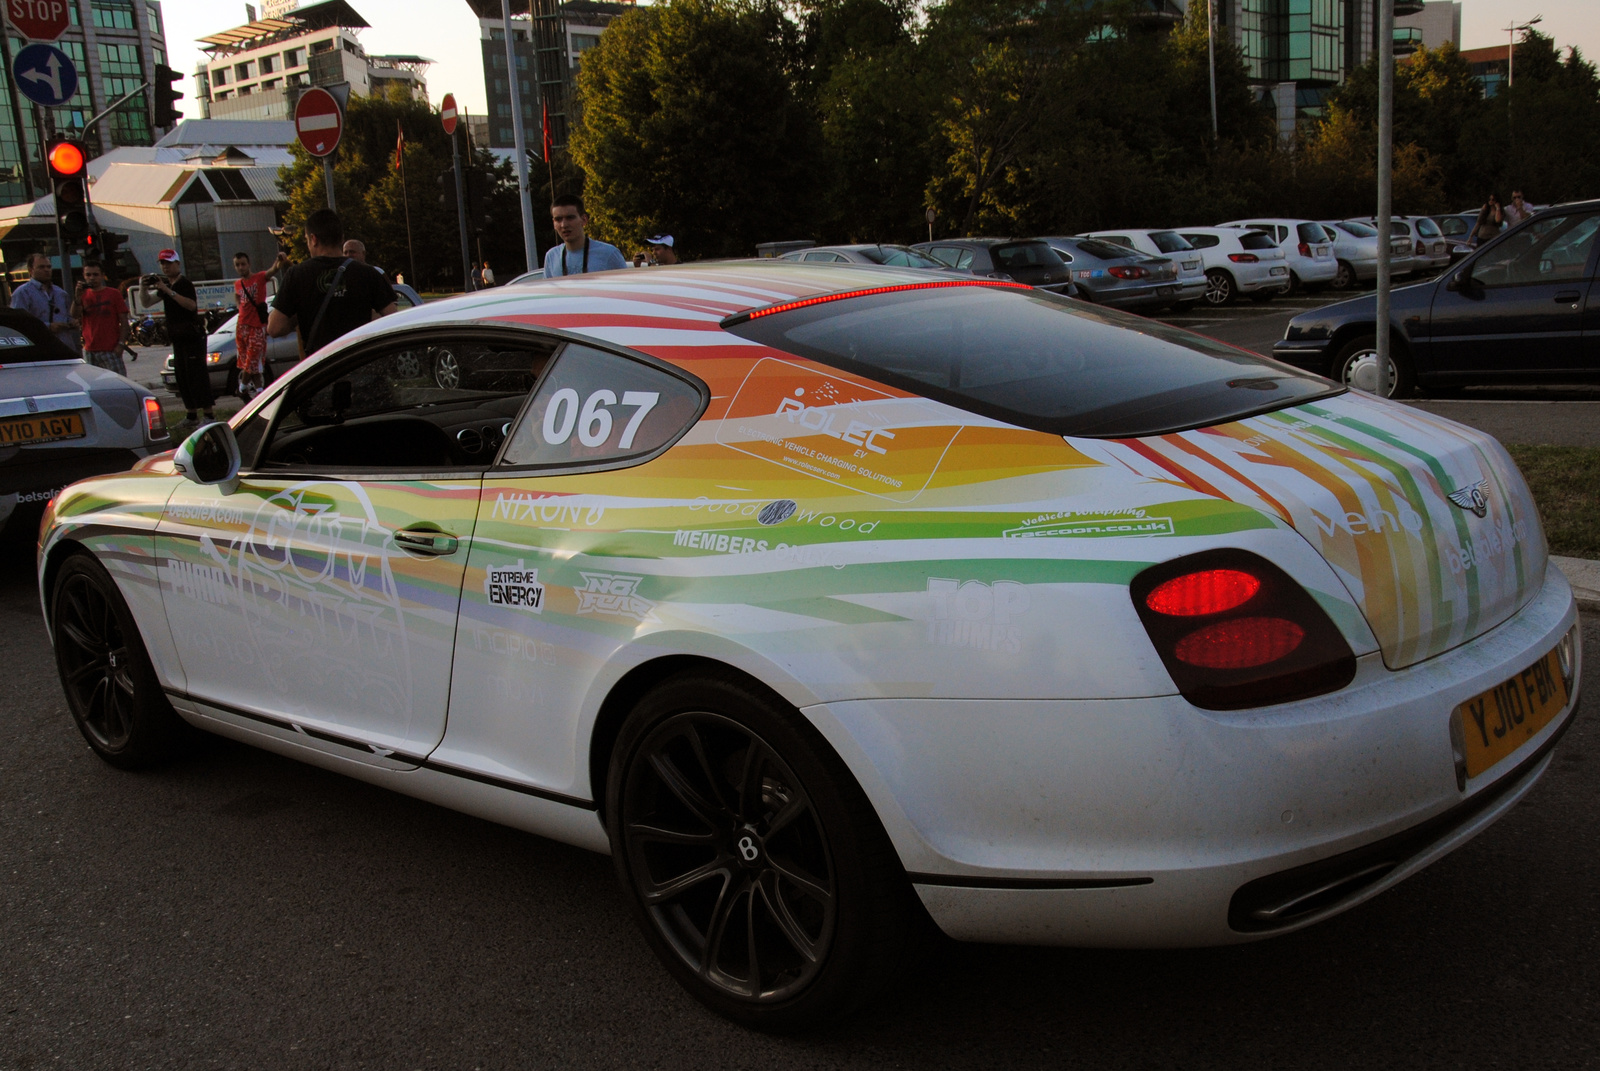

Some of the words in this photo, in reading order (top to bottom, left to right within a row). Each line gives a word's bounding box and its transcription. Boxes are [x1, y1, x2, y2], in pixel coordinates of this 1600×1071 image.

[12, 0, 62, 22] STOP
[197, 285, 235, 295] ONTINENT
[40, 418, 72, 438] AGV
[542, 387, 660, 449] 067
[774, 397, 896, 455] ROLEC
[738, 425, 784, 447] ELECTRONIC
[784, 437, 817, 458] VEHICLE
[816, 452, 857, 472] CHARGING
[857, 466, 903, 488] SOLUTIONS
[853, 448, 868, 459] EV
[782, 455, 841, 480] www.rolecserv.com
[16, 486, 66, 503] betsafe
[491, 492, 583, 523] NIXON
[1021, 511, 1071, 526] Vehicle
[1311, 499, 1423, 538] veho
[673, 529, 769, 555] MEMBERS
[1010, 522, 1167, 539] raccoon.co.uk
[491, 571, 534, 584] EXTREME
[588, 577, 635, 596] NO
[489, 583, 543, 608] ENERGY
[581, 592, 651, 617] FEAR
[927, 577, 1032, 625] TOP
[1469, 678, 1525, 748] YJ10
[1521, 654, 1557, 714] FBK
